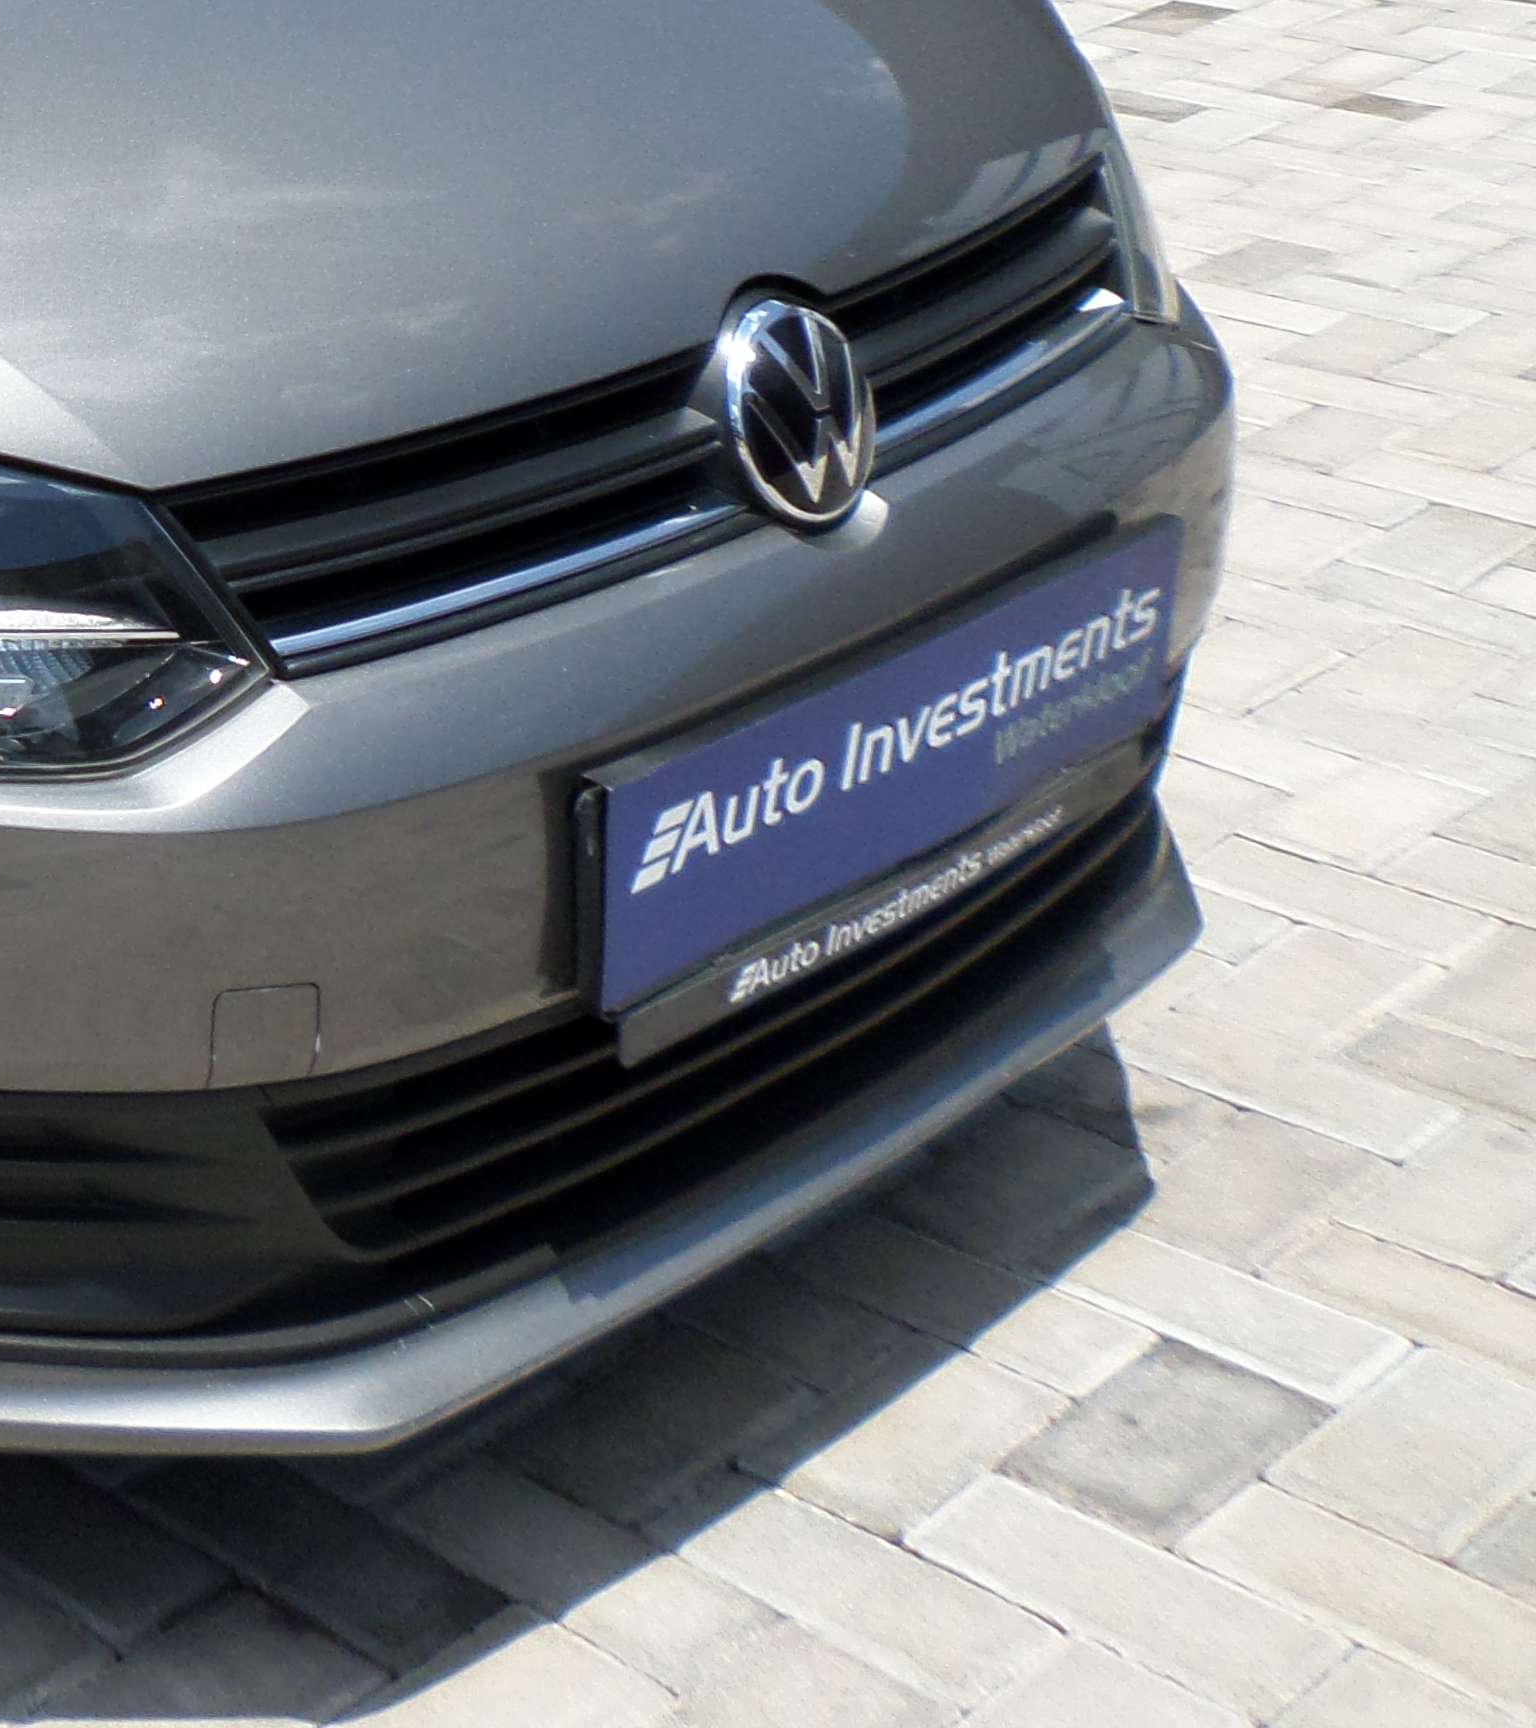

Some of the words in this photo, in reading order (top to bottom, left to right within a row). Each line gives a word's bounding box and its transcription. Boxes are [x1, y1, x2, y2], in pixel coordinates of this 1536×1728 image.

[671, 756, 826, 874] Auto
[839, 586, 1162, 791] Investments
[824, 850, 984, 957] Investments
